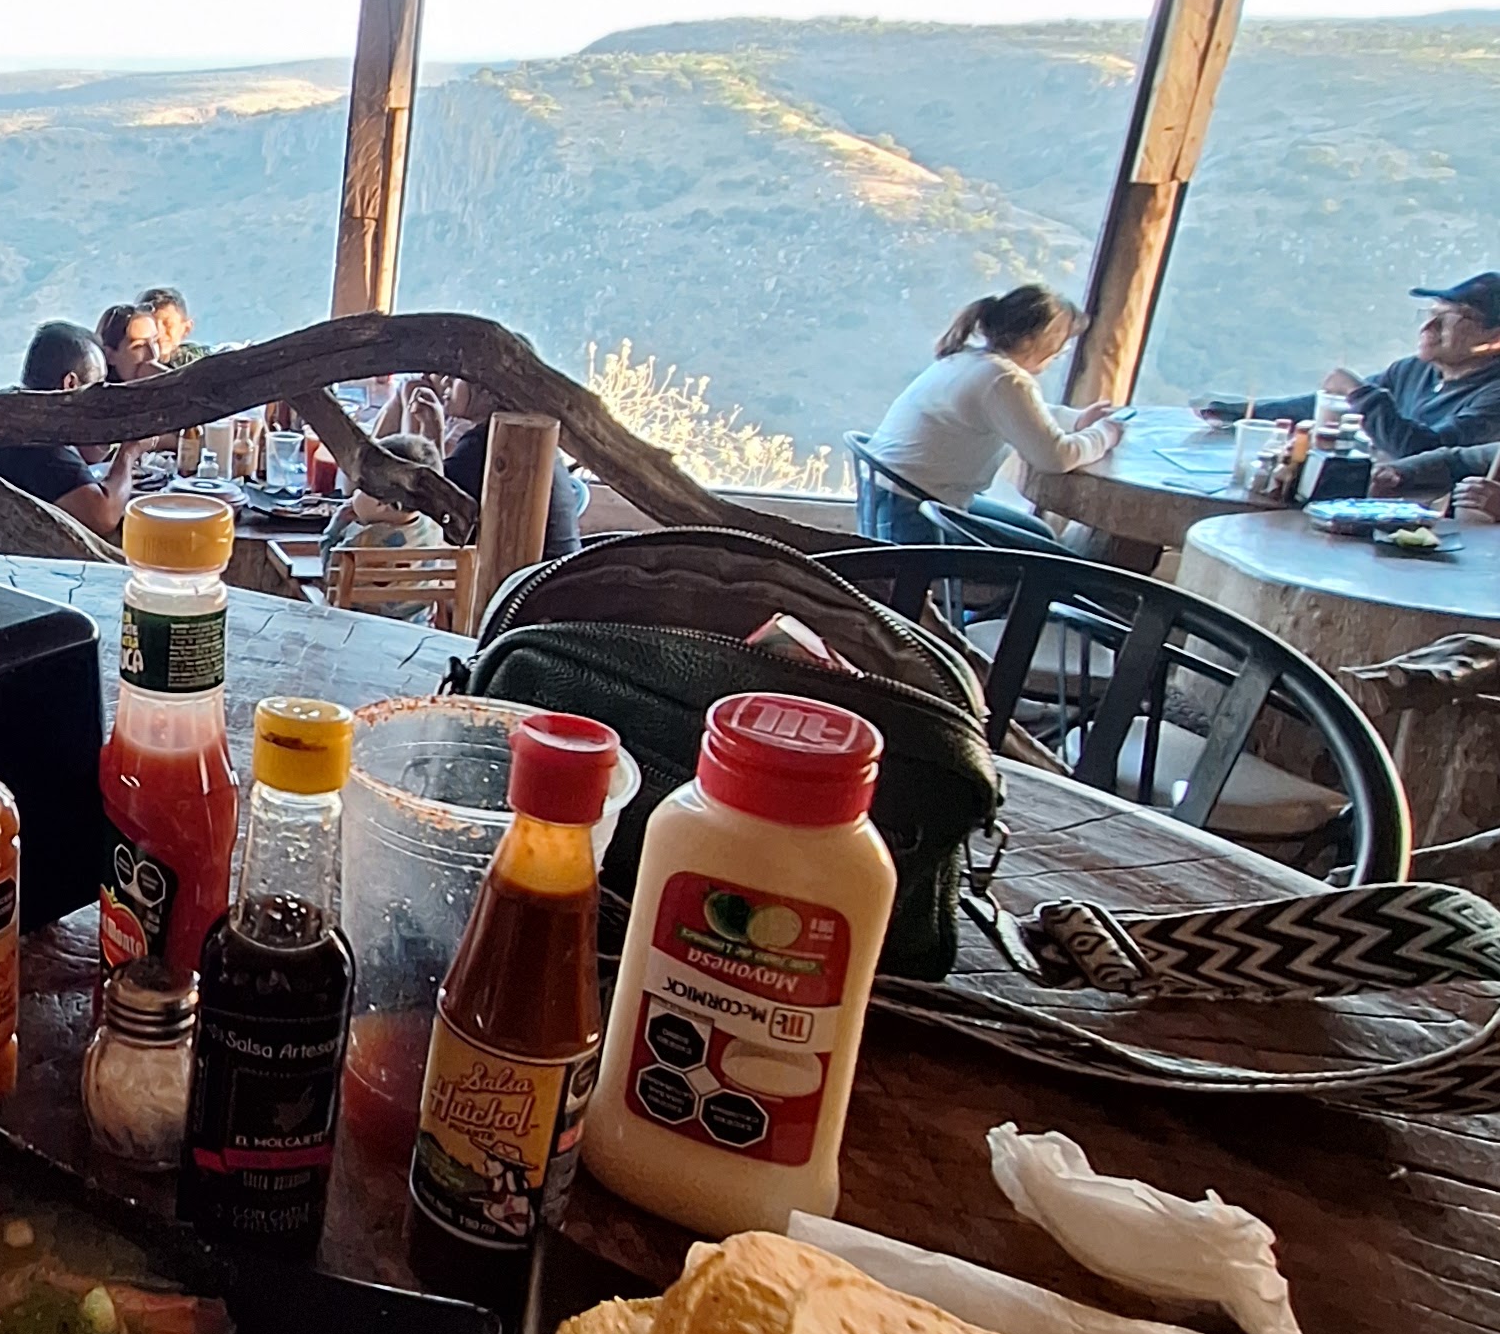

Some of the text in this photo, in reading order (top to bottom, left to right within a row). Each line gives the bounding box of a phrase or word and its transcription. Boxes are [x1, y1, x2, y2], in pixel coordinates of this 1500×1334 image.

[687, 947, 799, 993] Mayonesa
[662, 976, 768, 1024] McCORMICK
[225, 1030, 273, 1059] Salsa
[460, 1061, 535, 1094] Salsa
[430, 1075, 540, 1137] Huichol
